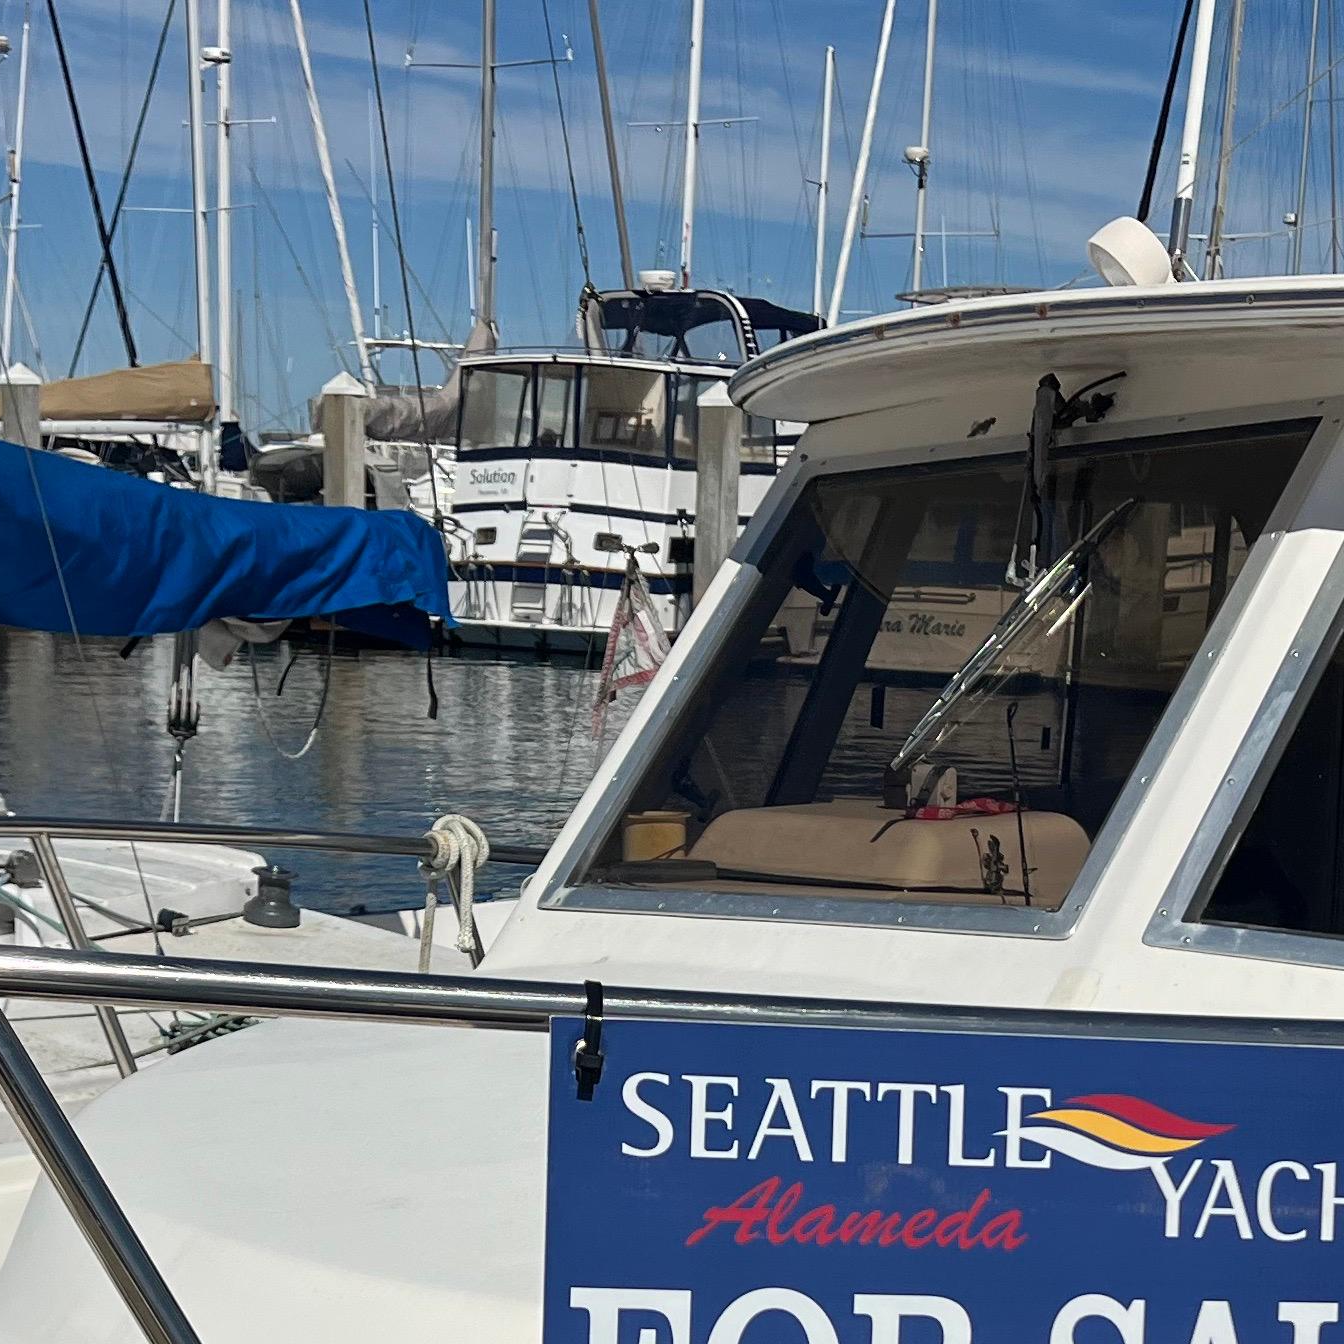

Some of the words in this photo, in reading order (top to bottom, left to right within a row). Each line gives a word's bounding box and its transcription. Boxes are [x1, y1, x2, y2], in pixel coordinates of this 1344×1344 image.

[470, 467, 517, 485] Solution
[908, 613, 966, 637] Marie
[621, 1072, 1054, 1170] SEATTLE
[686, 1176, 1028, 1252] Alameda
